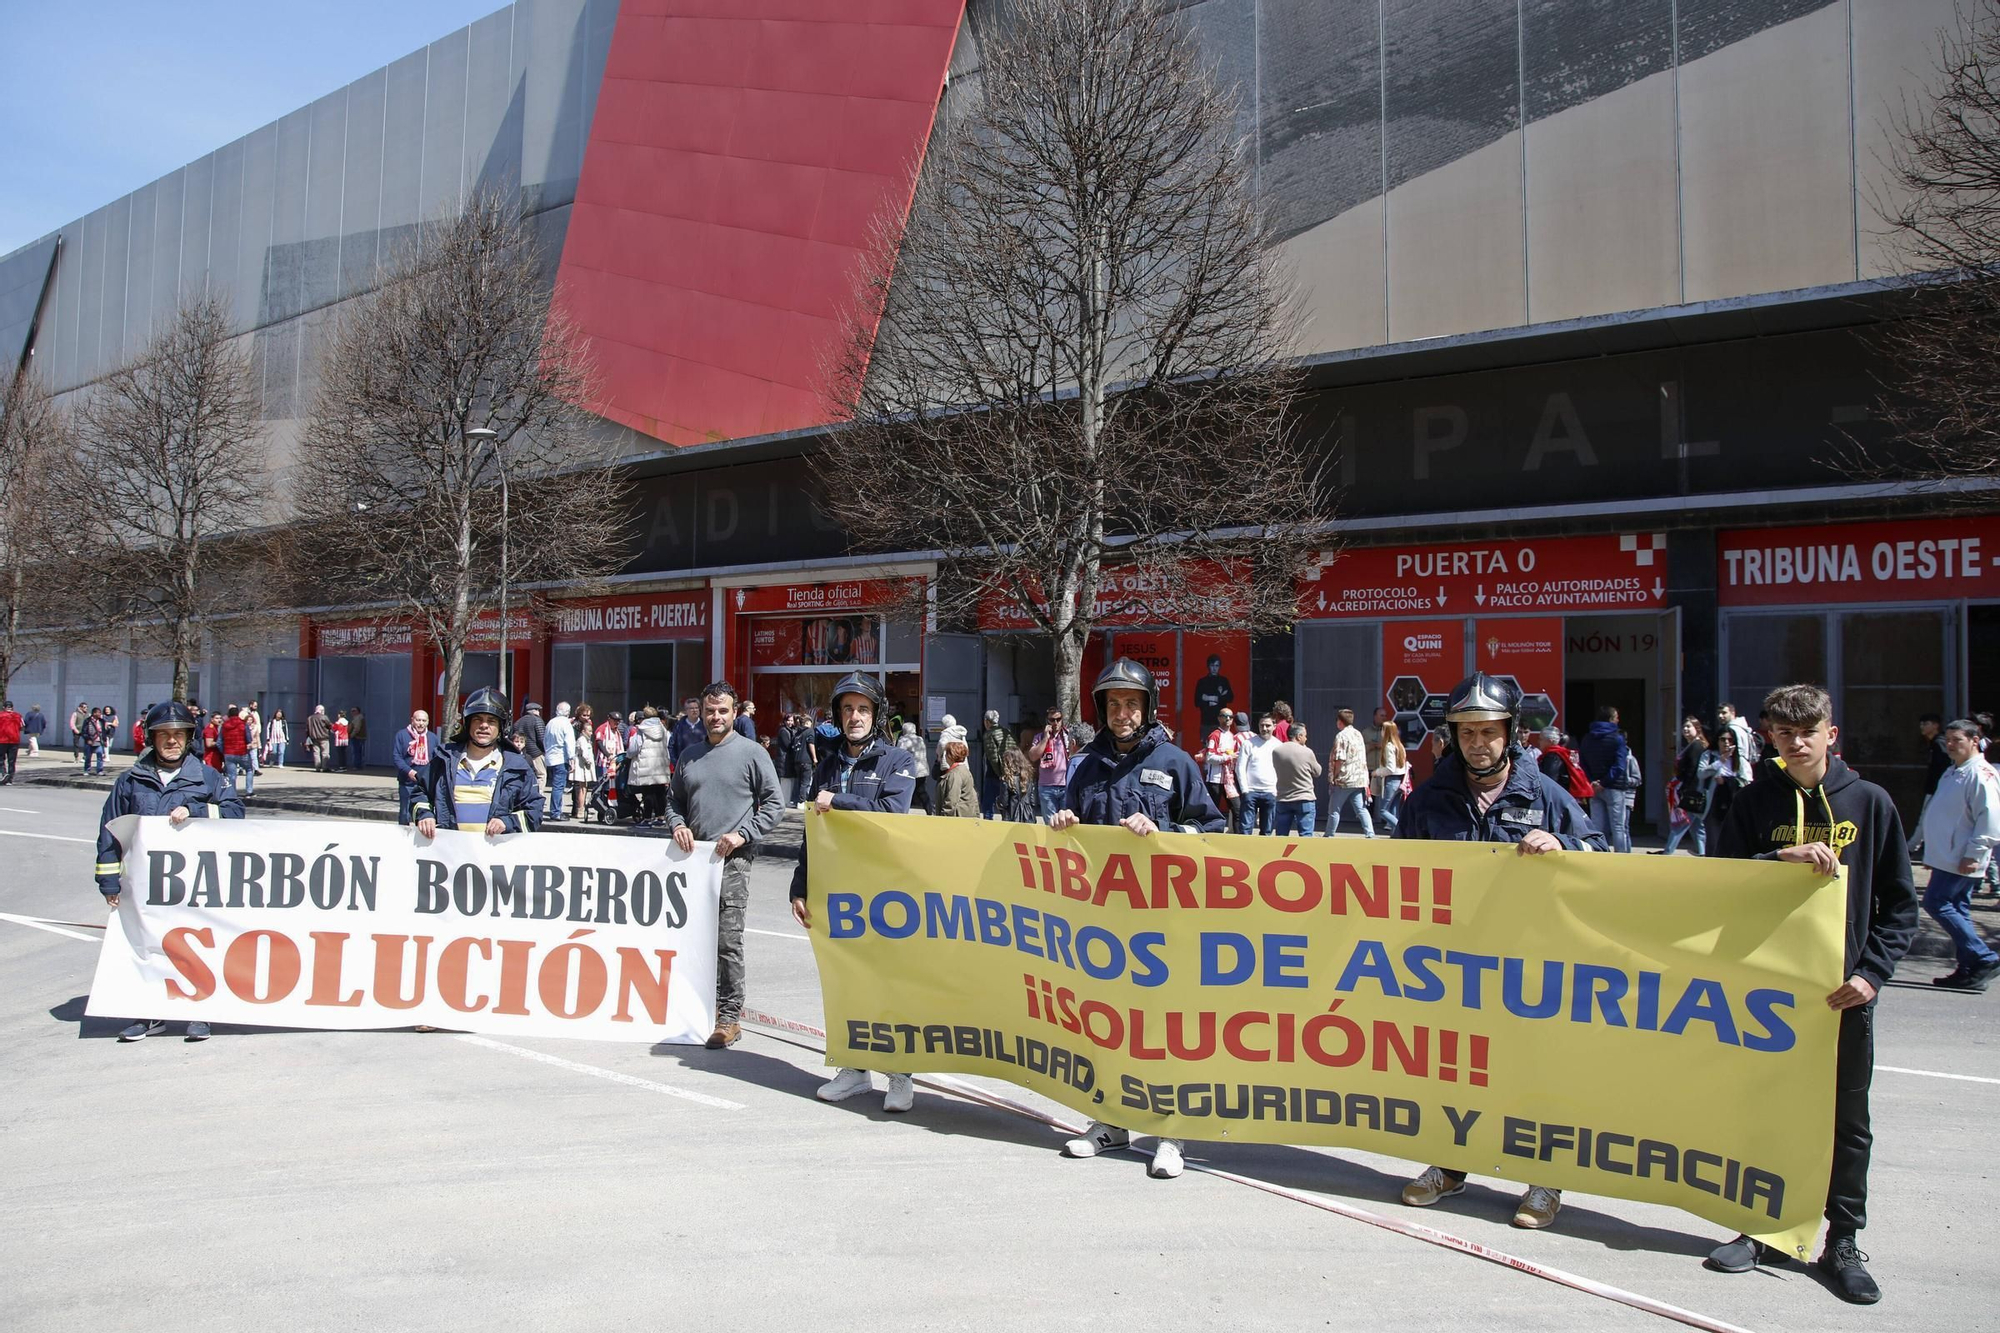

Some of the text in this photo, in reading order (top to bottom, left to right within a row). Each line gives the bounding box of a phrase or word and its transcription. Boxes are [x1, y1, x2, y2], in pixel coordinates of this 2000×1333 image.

[1396, 548, 1536, 578] PUERTA 0
[1723, 543, 1862, 586] TRIBUNA
[1871, 537, 1981, 581] OESTE
[786, 583, 862, 602] Tienda oficial
[1342, 587, 1418, 600] PROTOCOLO
[1490, 590, 1648, 608] PALCO AYUNTAMIENTO
[1496, 577, 1641, 595] PALCO AUTORIDADES
[558, 608, 603, 632] TRIBUNA
[605, 606, 641, 630] OESTE
[651, 602, 697, 628] PUERTA
[798, 600, 825, 608] SPORTING
[1329, 597, 1432, 612] ACREDITACIONES
[1403, 636, 1443, 652] QUINI
[1837, 826, 1856, 841] 81
[145, 842, 688, 930] BARBÓN BOMBEROS
[1013, 842, 1454, 926] ¡¡BARBÓN!!
[161, 926, 678, 1026] SOLUCIÓN
[826, 890, 1797, 1053] BOMBEROS DE ASTURIAS
[1023, 972, 1490, 1088] ¡¡SOLUCIÓN!!
[846, 1019, 1786, 1221] ESTABILIDAD, SEGURIDAD Y EFICACIA
